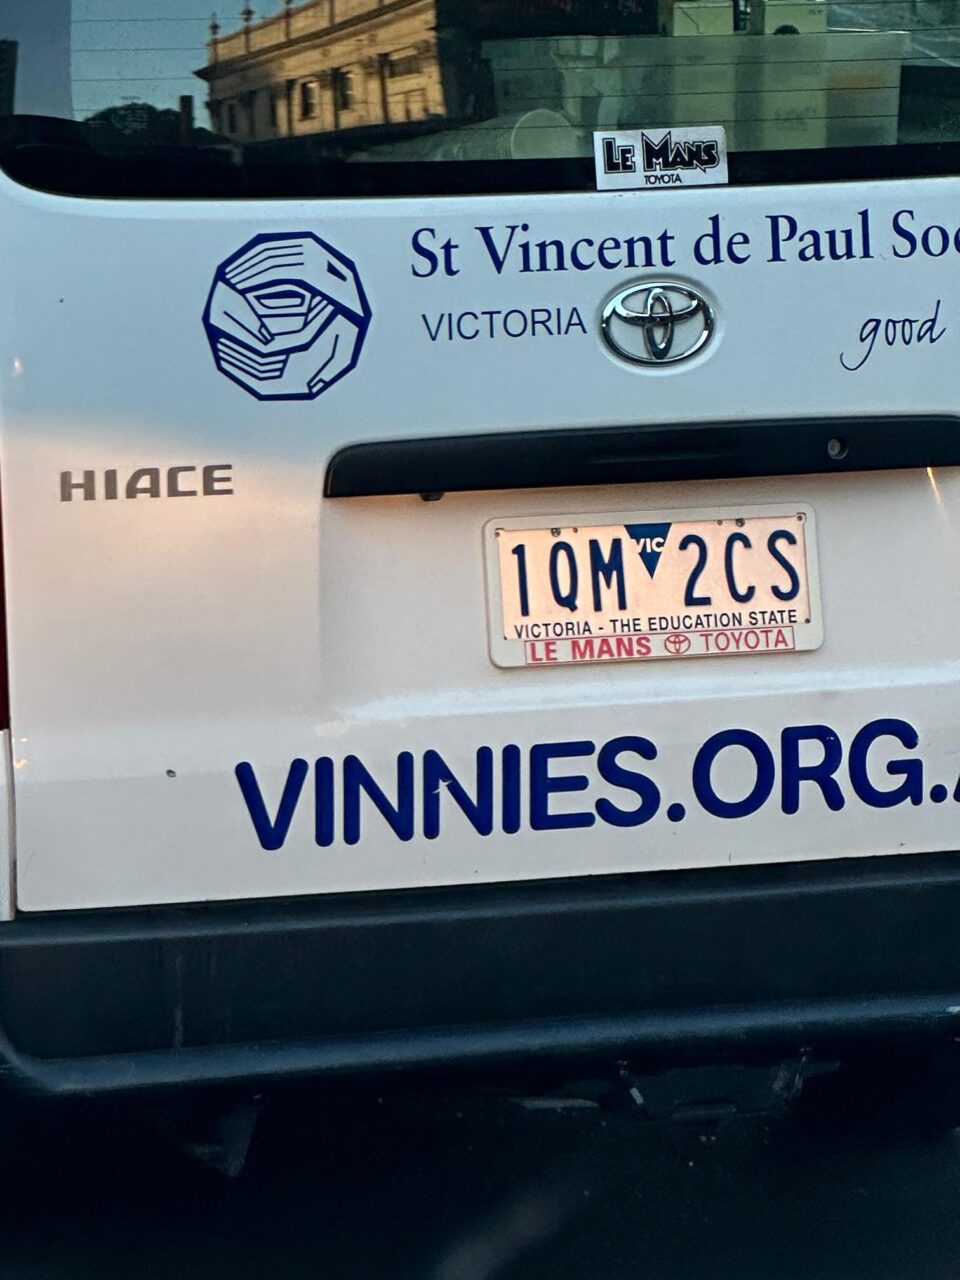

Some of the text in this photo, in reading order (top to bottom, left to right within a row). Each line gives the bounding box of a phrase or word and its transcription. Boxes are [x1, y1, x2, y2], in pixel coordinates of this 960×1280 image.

[644, 174, 682, 184] TOYOTA
[411, 226, 459, 278] St
[475, 223, 675, 274] Vincent
[693, 214, 750, 265] de
[765, 208, 874, 263] Paul
[422, 307, 587, 341] VICTORIA
[840, 300, 946, 370] good
[60, 464, 234, 502] HIACE
[632, 537, 664, 553] VIC
[511, 529, 800, 617] 1QM 2CS
[514, 621, 591, 639] VICTORIA
[609, 618, 641, 633] THE
[648, 612, 742, 631] EDUCATION
[749, 609, 798, 625] STATE
[530, 628, 788, 662] LE MANS TOYOTA
